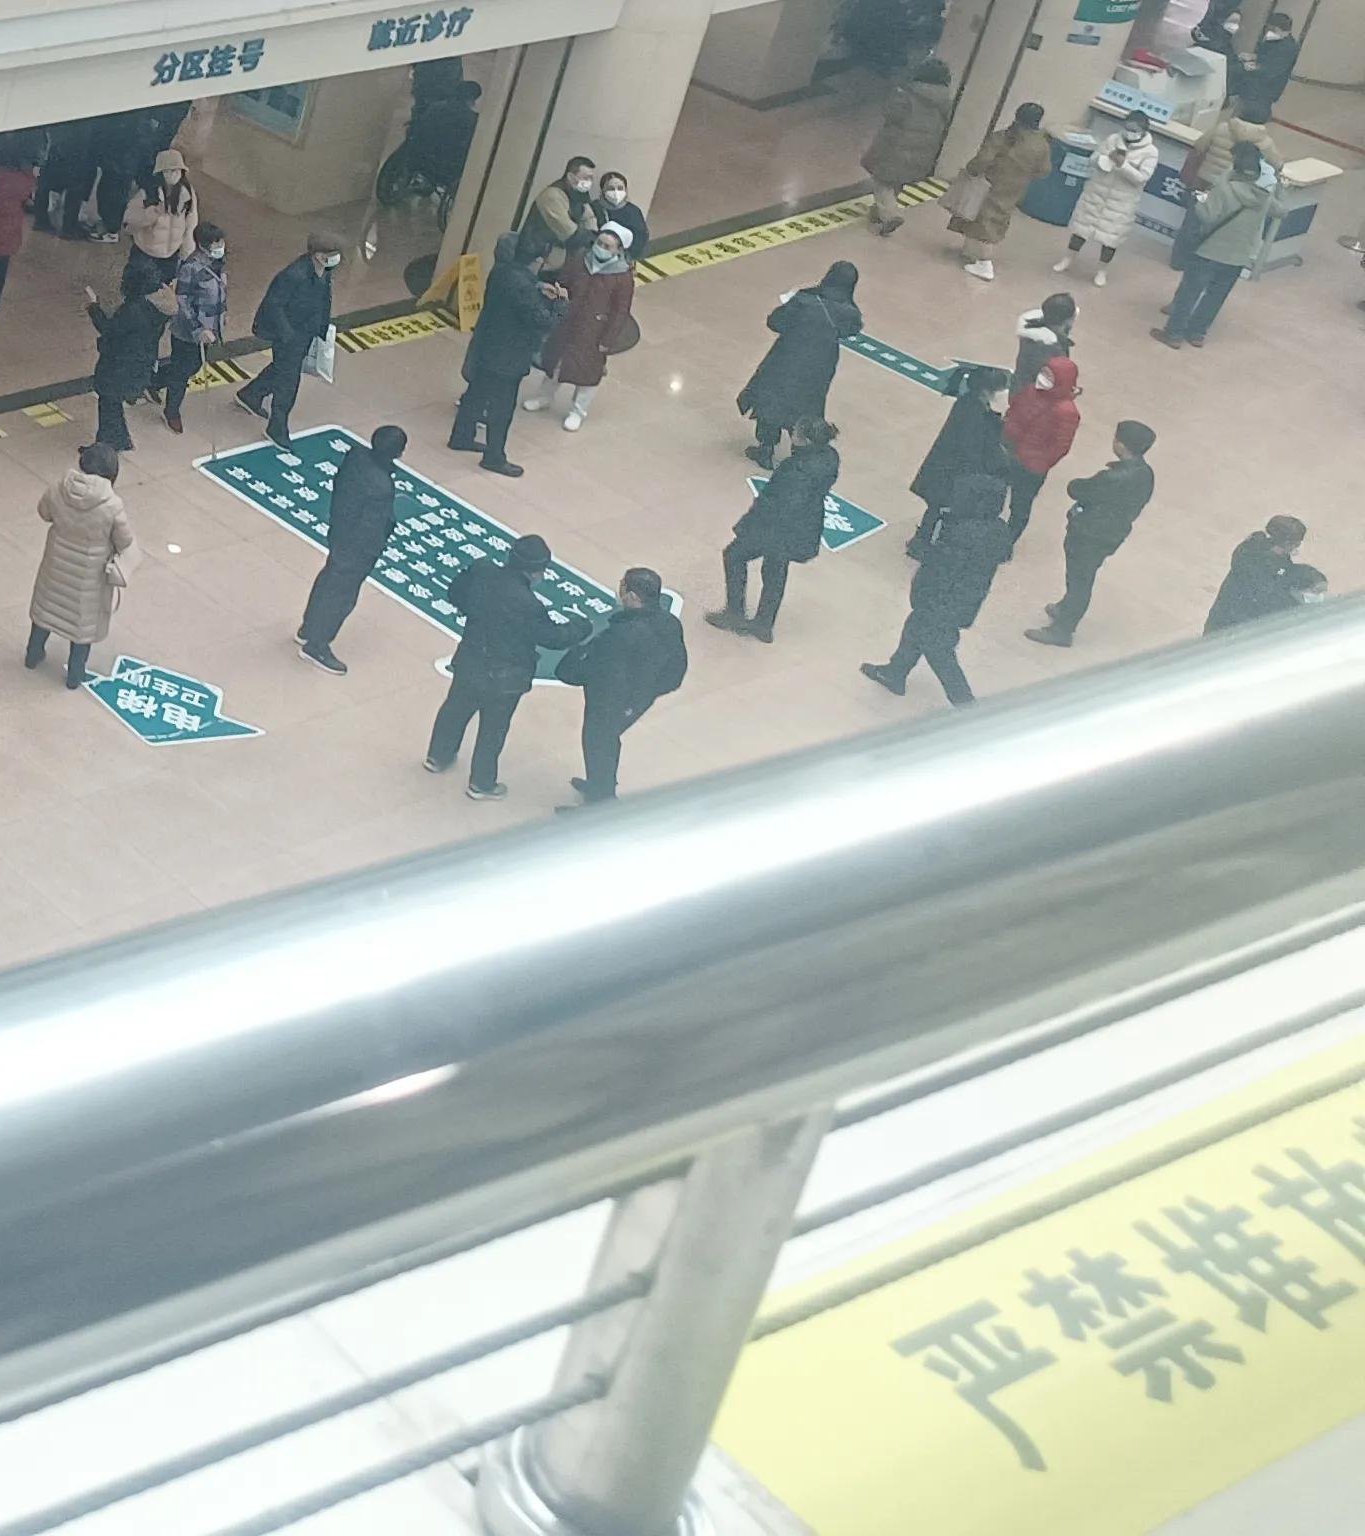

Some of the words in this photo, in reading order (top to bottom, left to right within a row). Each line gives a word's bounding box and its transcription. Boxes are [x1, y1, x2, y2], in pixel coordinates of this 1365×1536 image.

[149, 37, 266, 87] 分区挂号
[115, 688, 202, 733] 电梯
[120, 667, 210, 709] 卫生间
